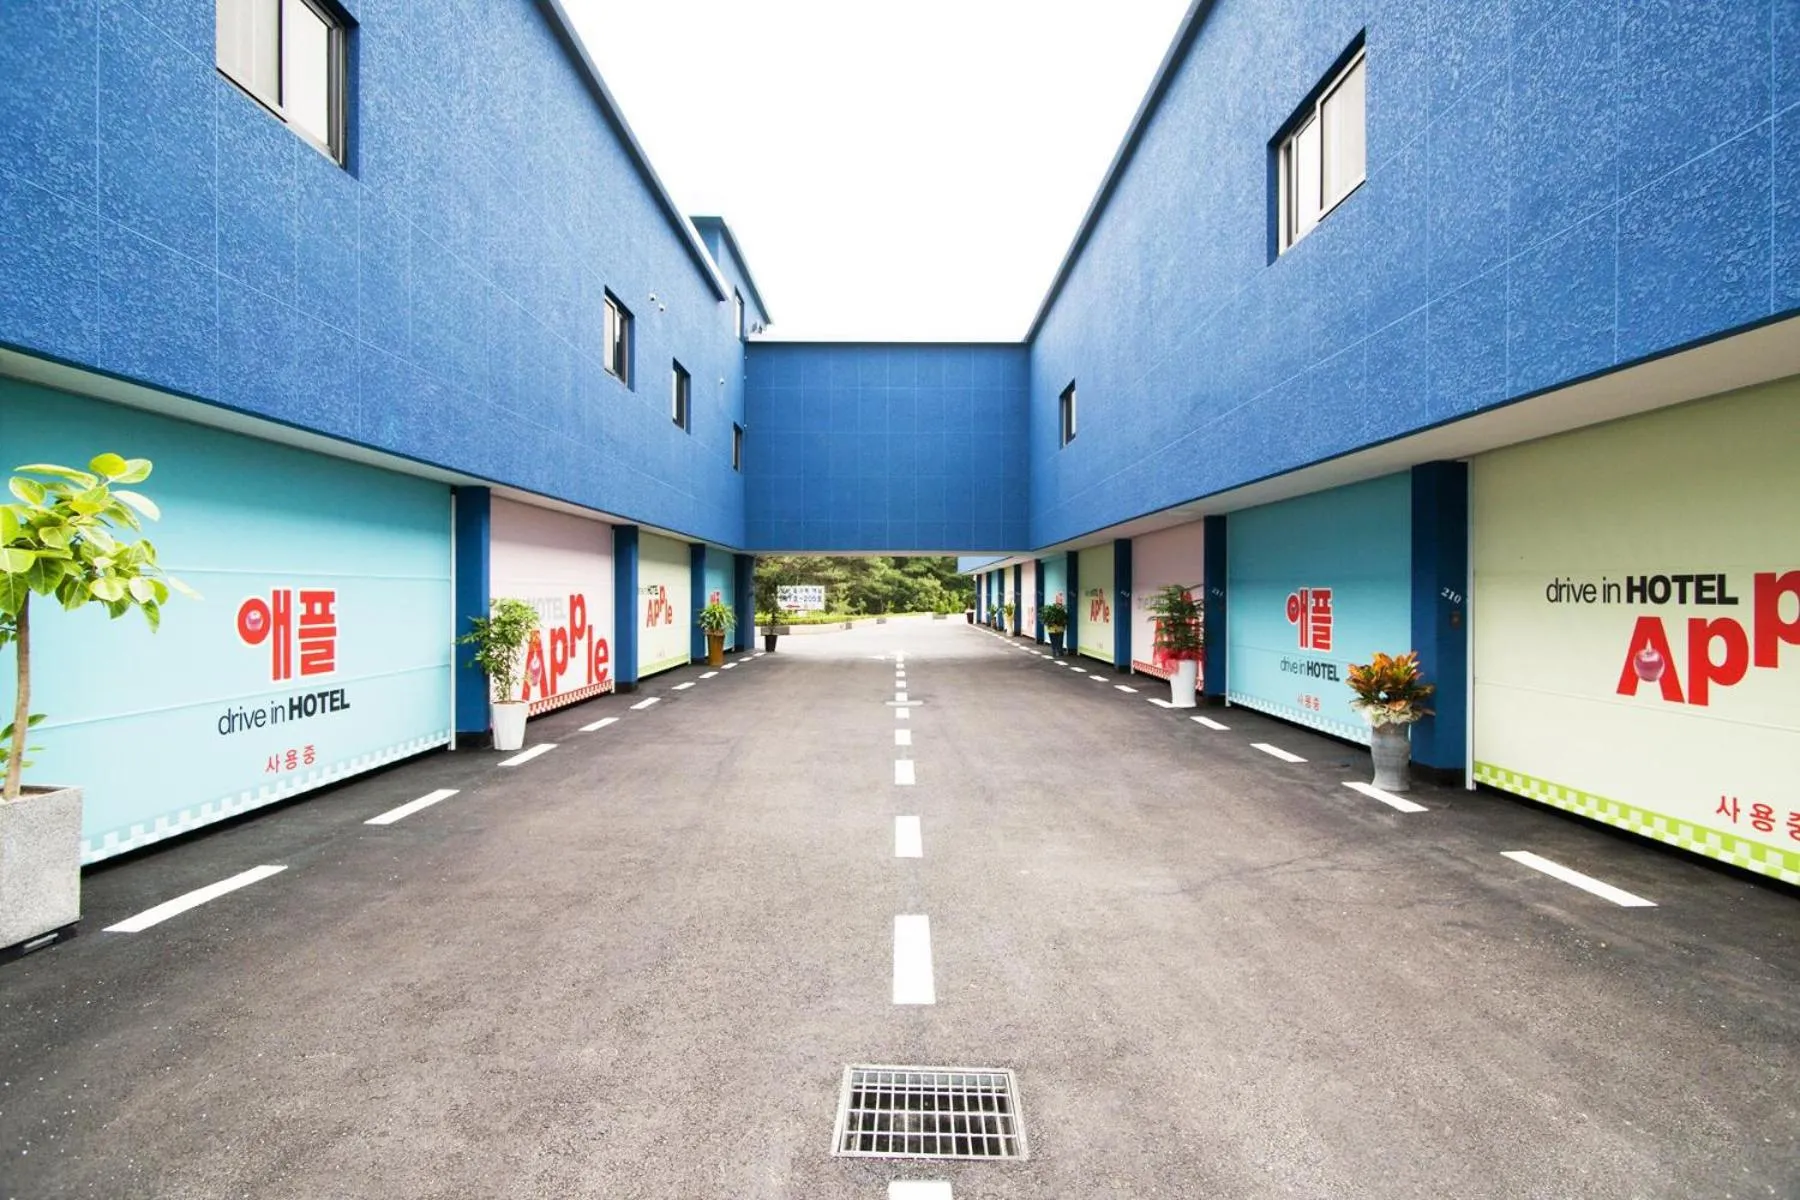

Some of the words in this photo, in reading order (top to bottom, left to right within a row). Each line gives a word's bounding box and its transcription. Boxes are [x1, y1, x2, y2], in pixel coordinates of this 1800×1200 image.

[528, 597, 566, 620] OTEL
[646, 586, 673, 629] Apple
[1440, 587, 1462, 604] 210
[1546, 577, 1597, 604] drive
[1603, 577, 1621, 604] in
[1626, 574, 1739, 606] HOTEL
[237, 590, 337, 681] 애플
[1286, 588, 1332, 651] 애플
[522, 594, 609, 702] Apple
[1280, 656, 1298, 674] drive
[1307, 660, 1340, 682] HOTEL
[218, 706, 266, 735] drive
[271, 701, 285, 724] in
[288, 688, 350, 720] HOTEL
[265, 744, 315, 773] 사용중
